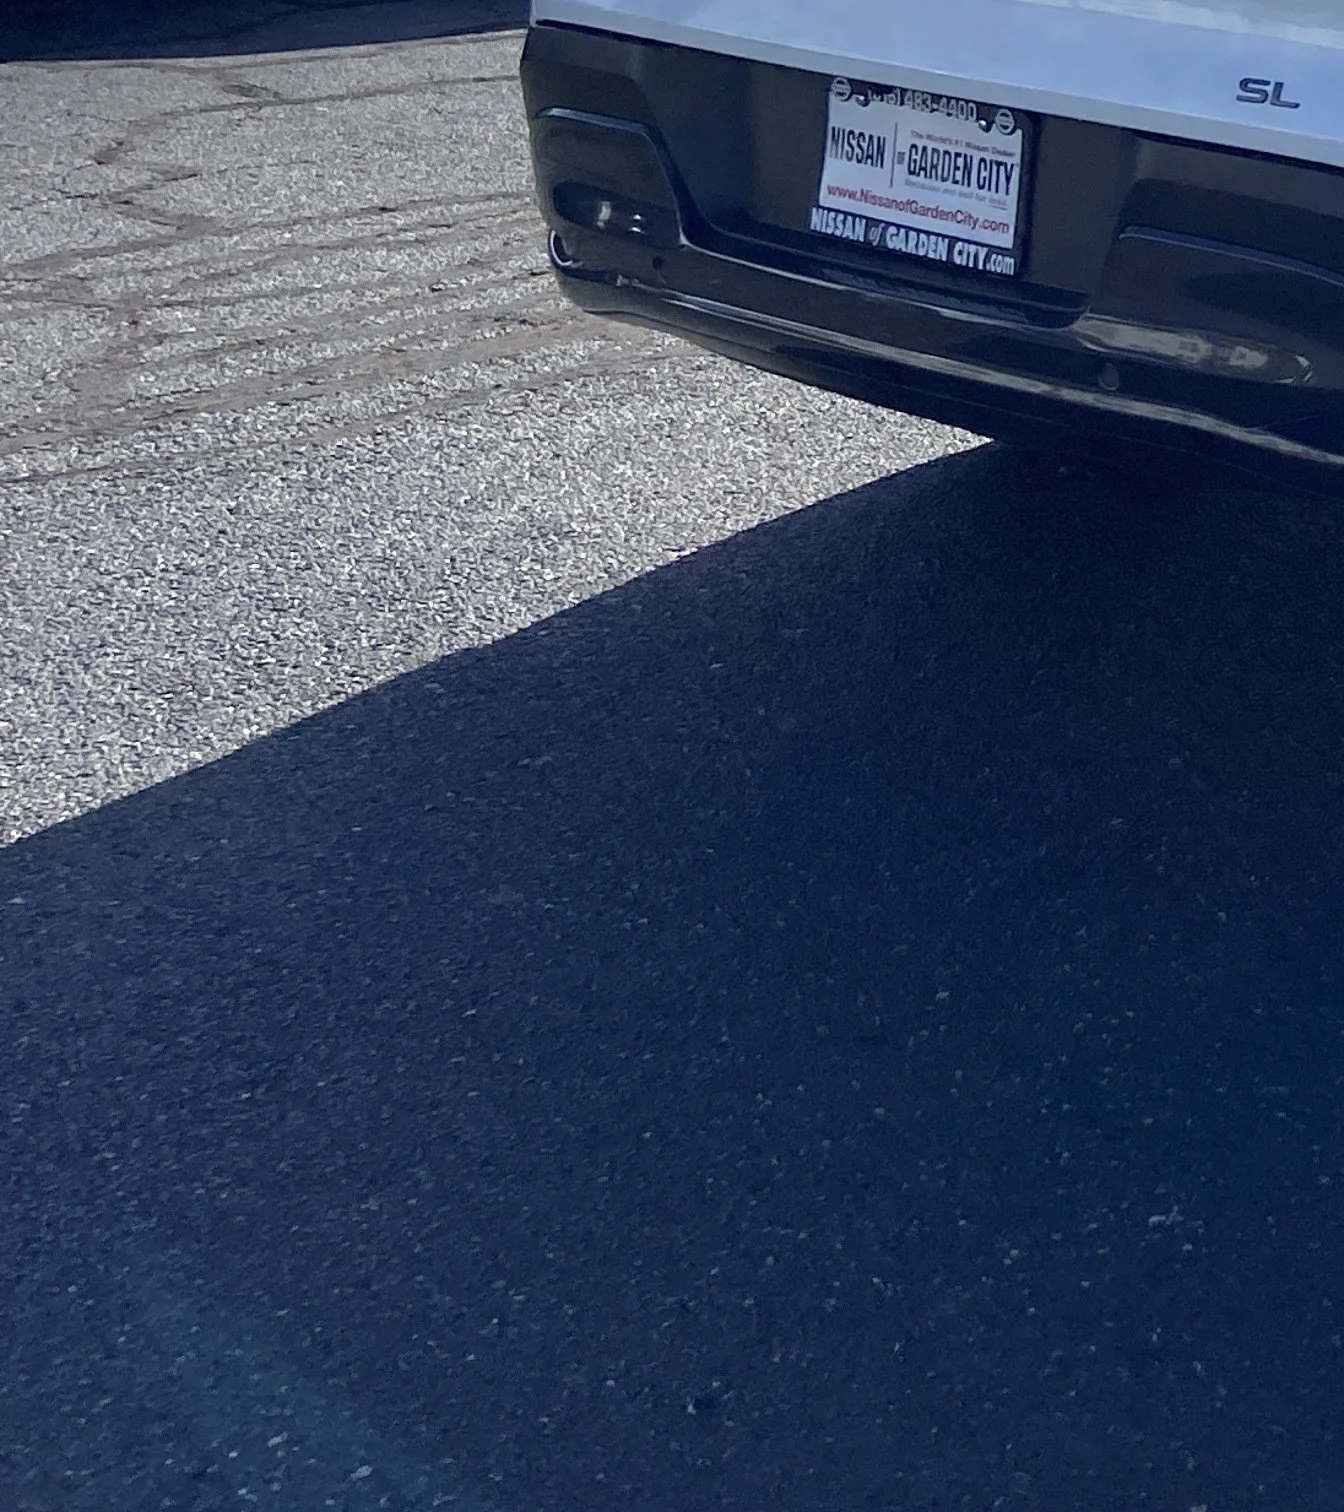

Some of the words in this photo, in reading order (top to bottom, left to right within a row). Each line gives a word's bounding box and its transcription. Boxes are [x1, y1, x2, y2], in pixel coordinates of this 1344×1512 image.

[904, 90, 977, 120] 483-4400
[1236, 77, 1301, 110] SL
[829, 126, 886, 168] NISSAN
[908, 144, 973, 187] GARDEN
[977, 157, 1014, 196] CITY
[827, 184, 1009, 233] www.NissanofGardenCity.com
[810, 206, 867, 242] NISSAN
[869, 223, 883, 246] of
[886, 225, 949, 262] GARDEN
